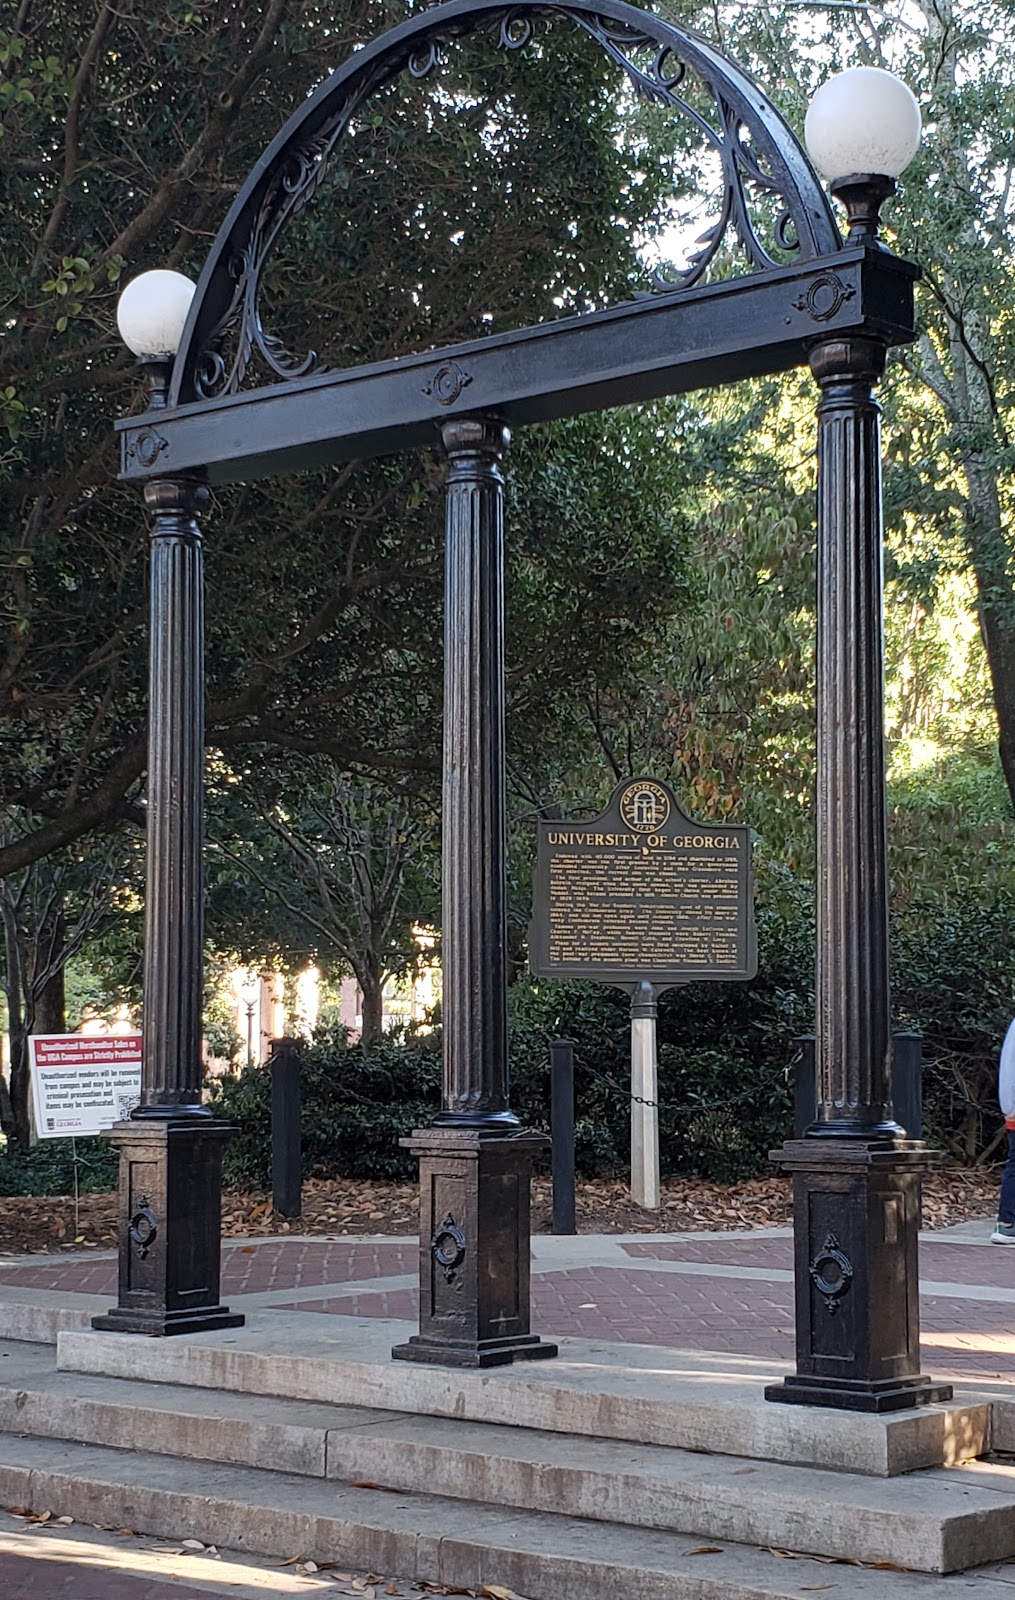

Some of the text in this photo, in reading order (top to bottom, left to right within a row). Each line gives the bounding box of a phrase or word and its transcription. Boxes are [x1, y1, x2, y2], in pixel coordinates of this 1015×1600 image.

[623, 784, 665, 804] GEORGIA
[548, 832, 740, 849] UNIVERSITY OF GEORGIA
[41, 1042, 78, 1051] Unauthorized
[47, 1053, 60, 1061] UGA
[61, 1052, 83, 1062] Campus
[94, 1051, 114, 1060] Strictly
[115, 1049, 142, 1058] Prohibited
[41, 1071, 77, 1079] Unauthorized
